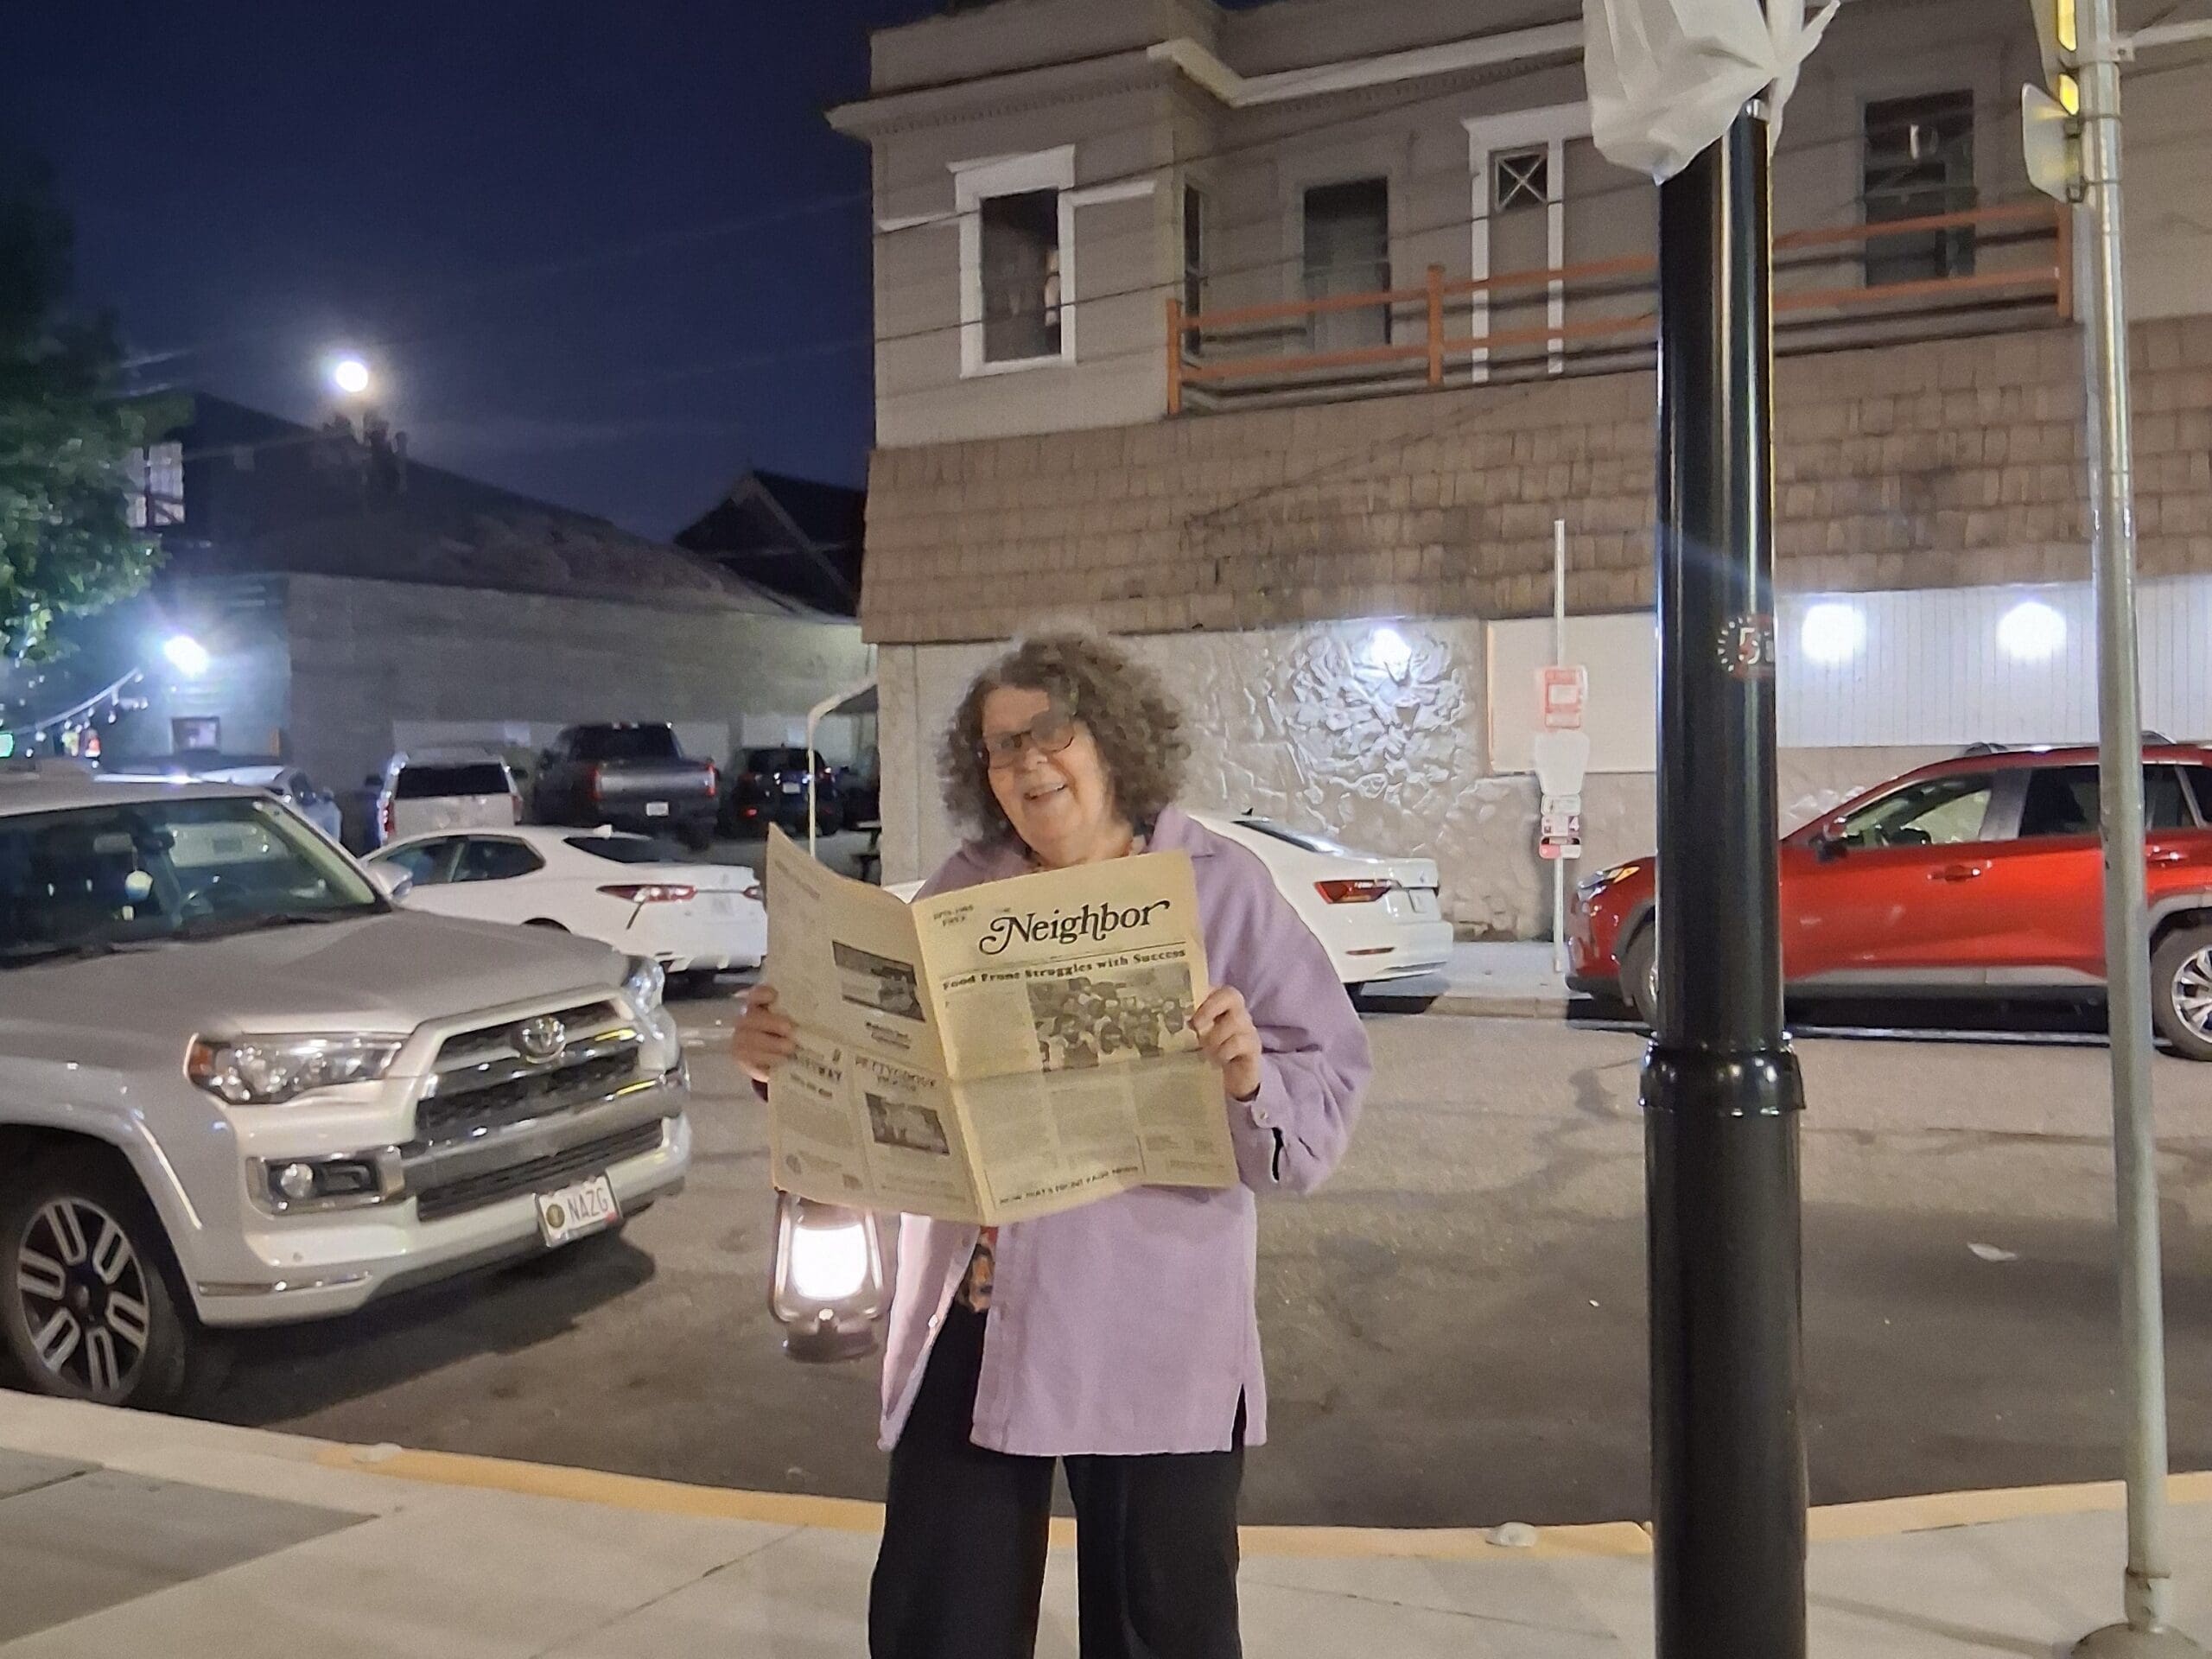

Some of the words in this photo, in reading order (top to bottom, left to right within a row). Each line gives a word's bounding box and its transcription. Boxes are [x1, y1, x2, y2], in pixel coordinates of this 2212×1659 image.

[979, 899, 1171, 956] Neighbor
[943, 975, 976, 990] Food
[1025, 963, 1092, 978] Struggles
[1096, 956, 1128, 969] with
[1133, 950, 1186, 963] Success
[567, 1186, 609, 1224] NAZG
